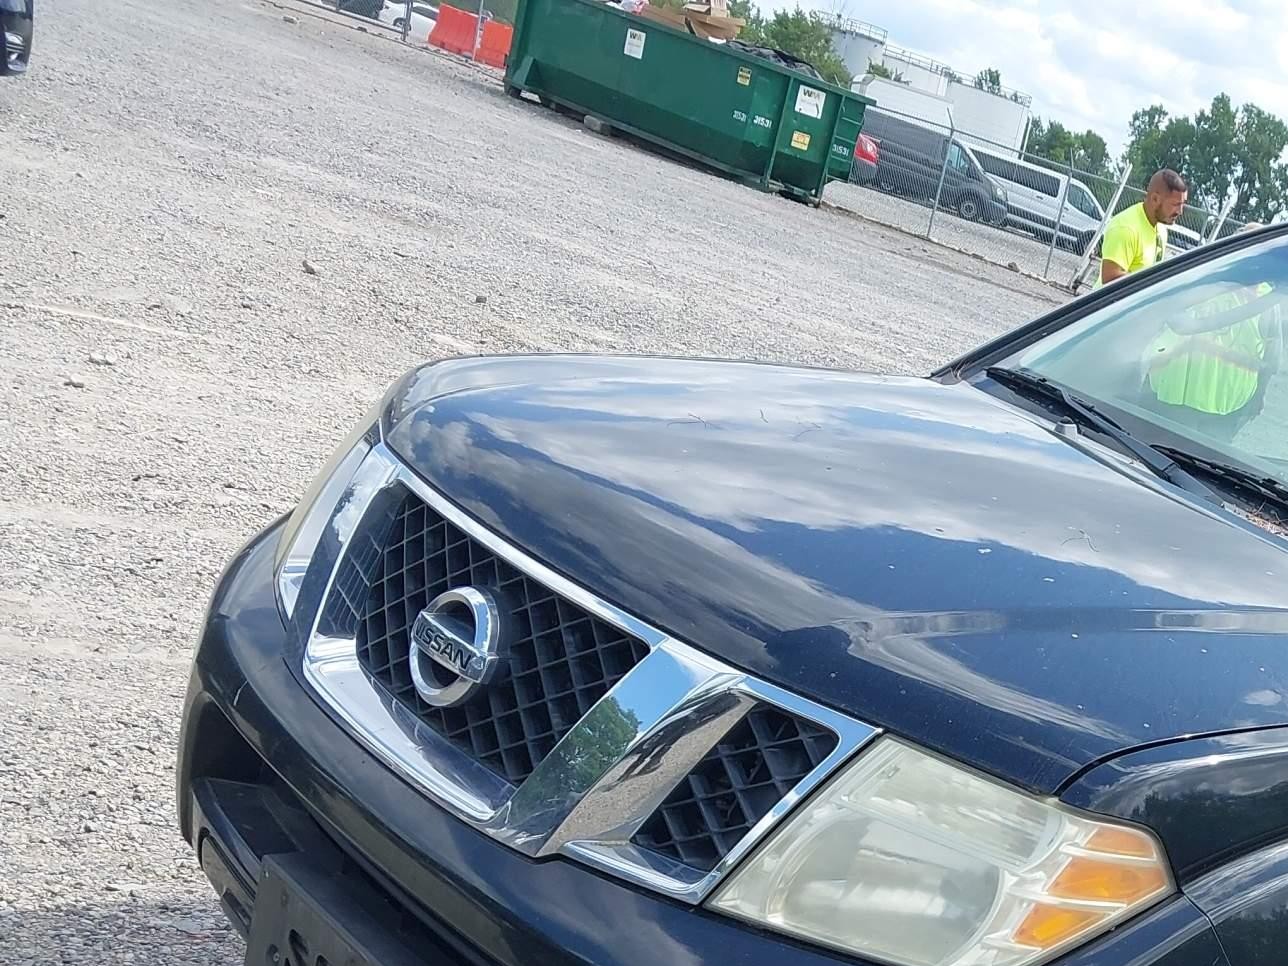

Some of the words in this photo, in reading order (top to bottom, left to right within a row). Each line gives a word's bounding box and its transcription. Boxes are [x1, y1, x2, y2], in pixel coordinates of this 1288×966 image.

[753, 115, 772, 128] 31531
[832, 143, 850, 156] 31531
[415, 621, 472, 670] NISSAN
